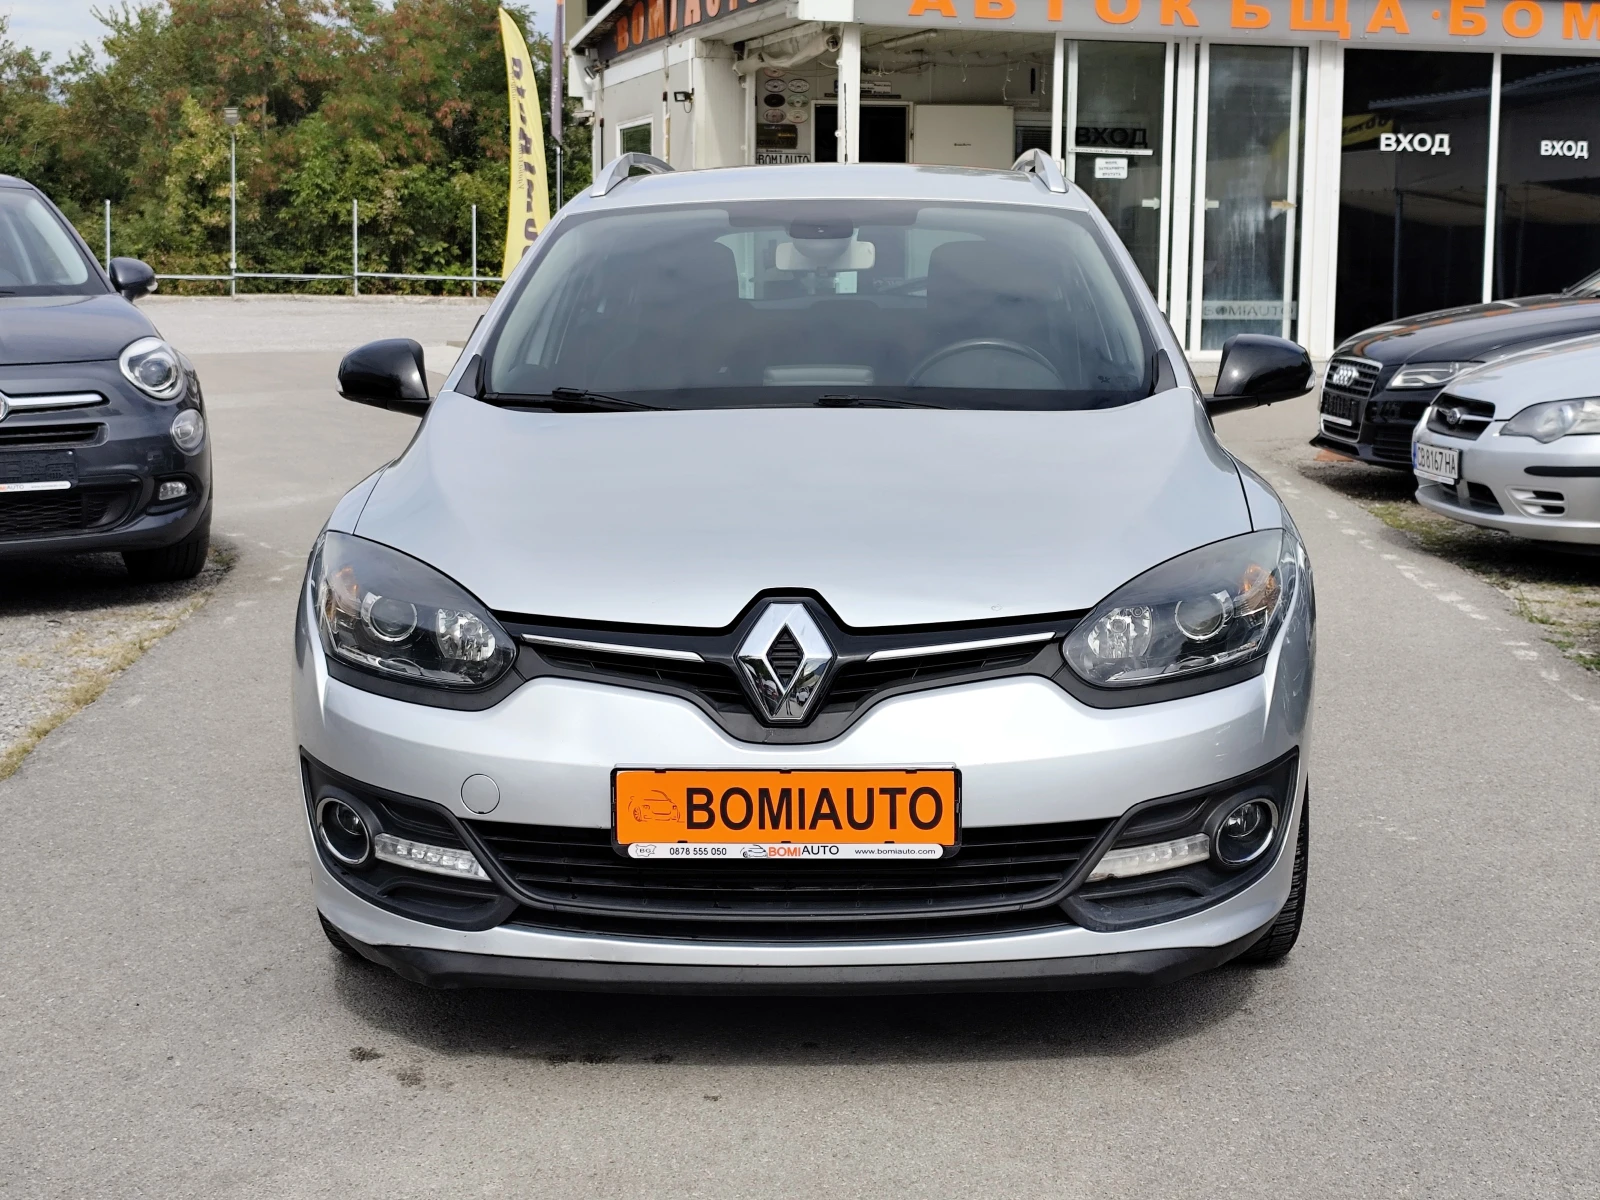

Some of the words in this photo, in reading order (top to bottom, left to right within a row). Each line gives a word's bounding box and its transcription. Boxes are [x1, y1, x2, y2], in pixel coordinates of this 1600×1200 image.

[616, 0, 758, 53] BOMIA
[1076, 127, 1148, 149] ВХОД
[1379, 132, 1451, 156] ВХОД
[1540, 140, 1589, 160] ВХОД
[685, 786, 944, 831] BOMIAUTO
[669, 847, 691, 855] 0878
[692, 847, 709, 855] 555
[710, 847, 727, 855] 050
[768, 845, 840, 857] BOMIAUTO
